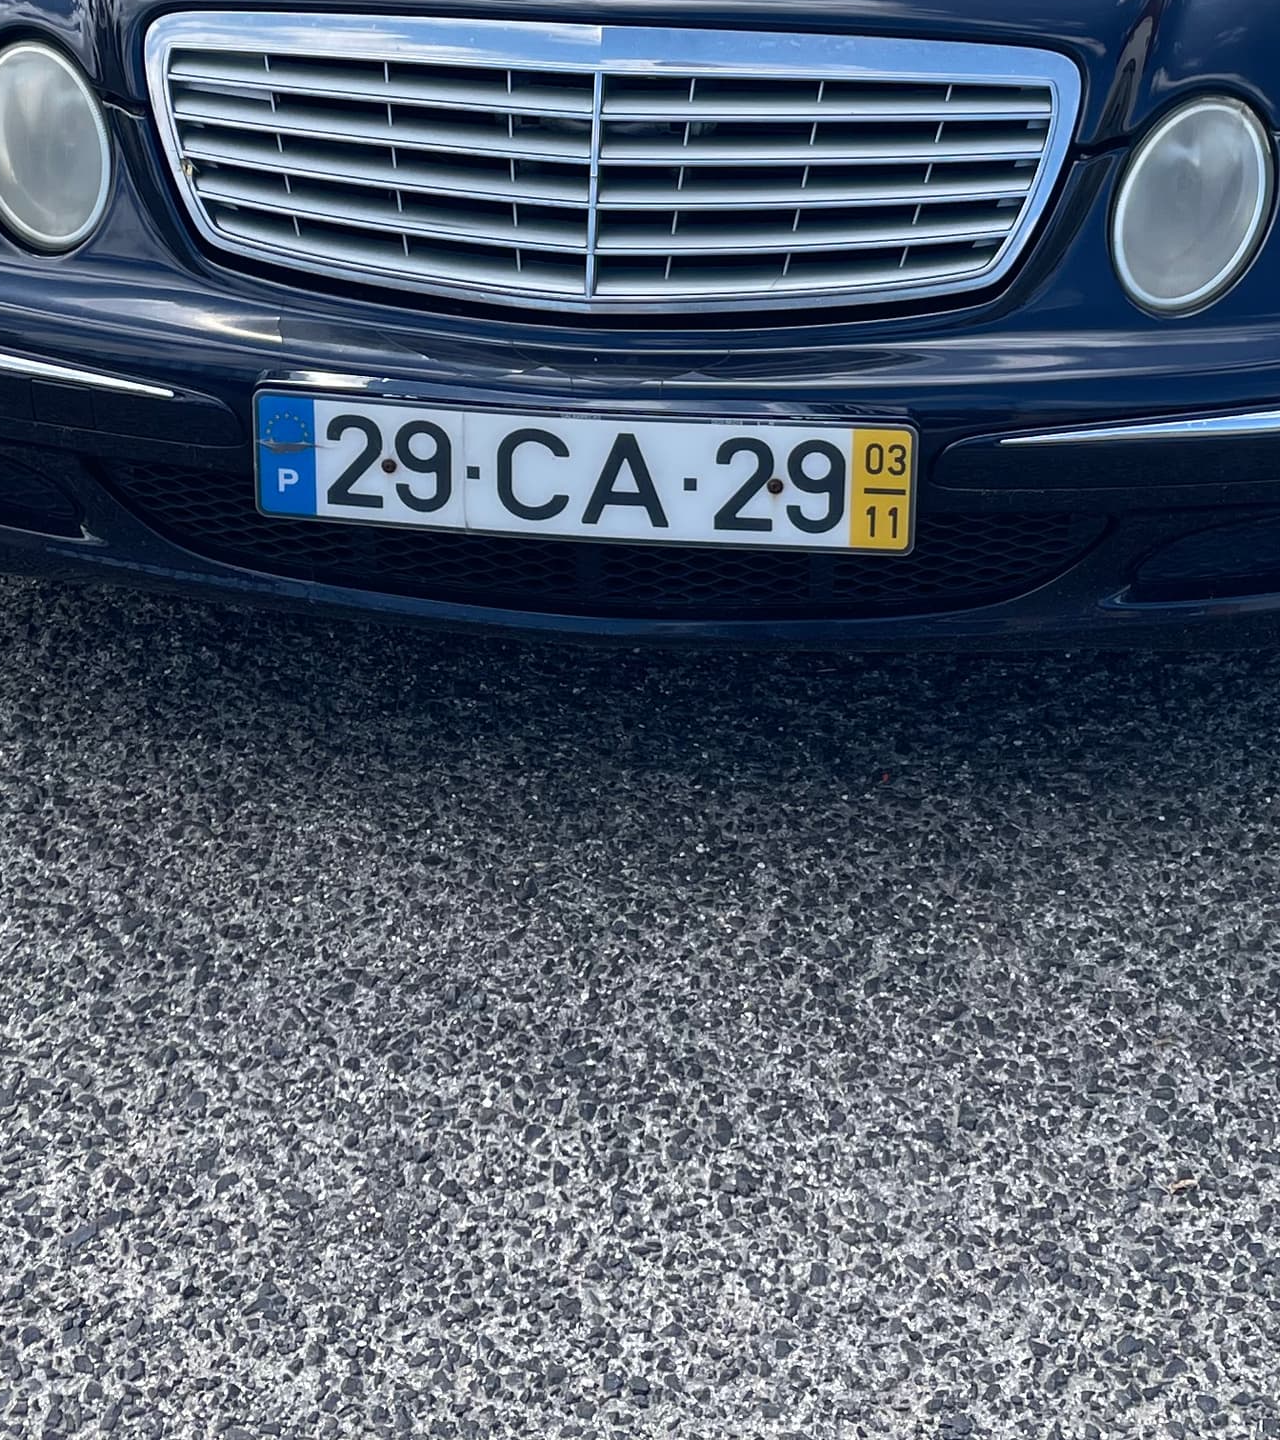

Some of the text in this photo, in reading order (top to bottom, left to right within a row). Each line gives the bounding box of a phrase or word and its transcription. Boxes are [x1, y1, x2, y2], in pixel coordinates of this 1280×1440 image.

[865, 443, 906, 476] 03
[278, 468, 298, 493] P
[865, 505, 899, 539] 11
